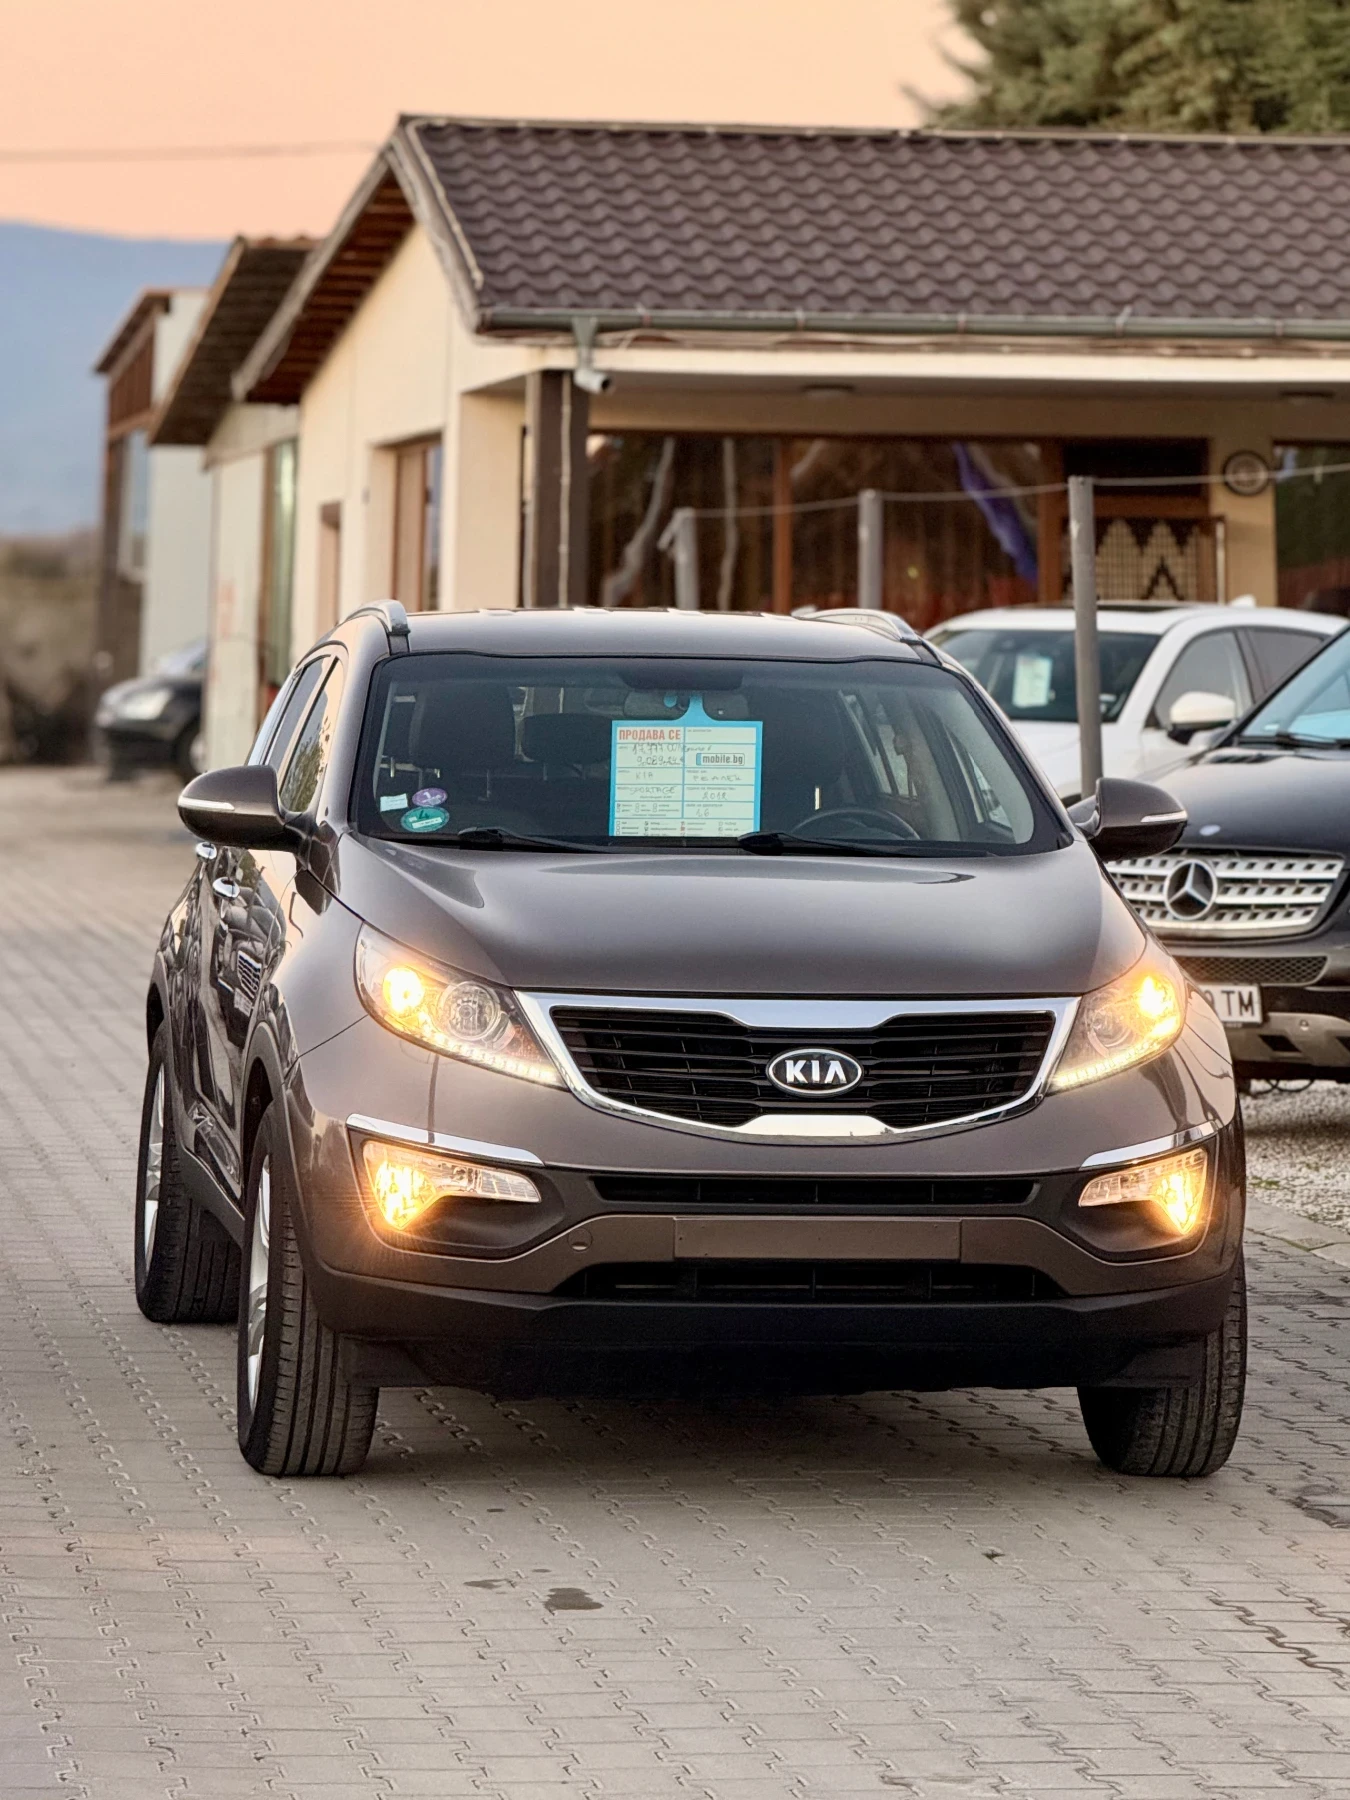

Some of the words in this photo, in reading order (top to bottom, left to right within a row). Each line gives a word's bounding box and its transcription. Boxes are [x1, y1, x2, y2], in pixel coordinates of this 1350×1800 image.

[619, 729, 665, 741] ПРОДАВА
[668, 729, 681, 740] СЕ
[702, 754, 743, 765] mobile.bg
[784, 1059, 847, 1084] KIA
